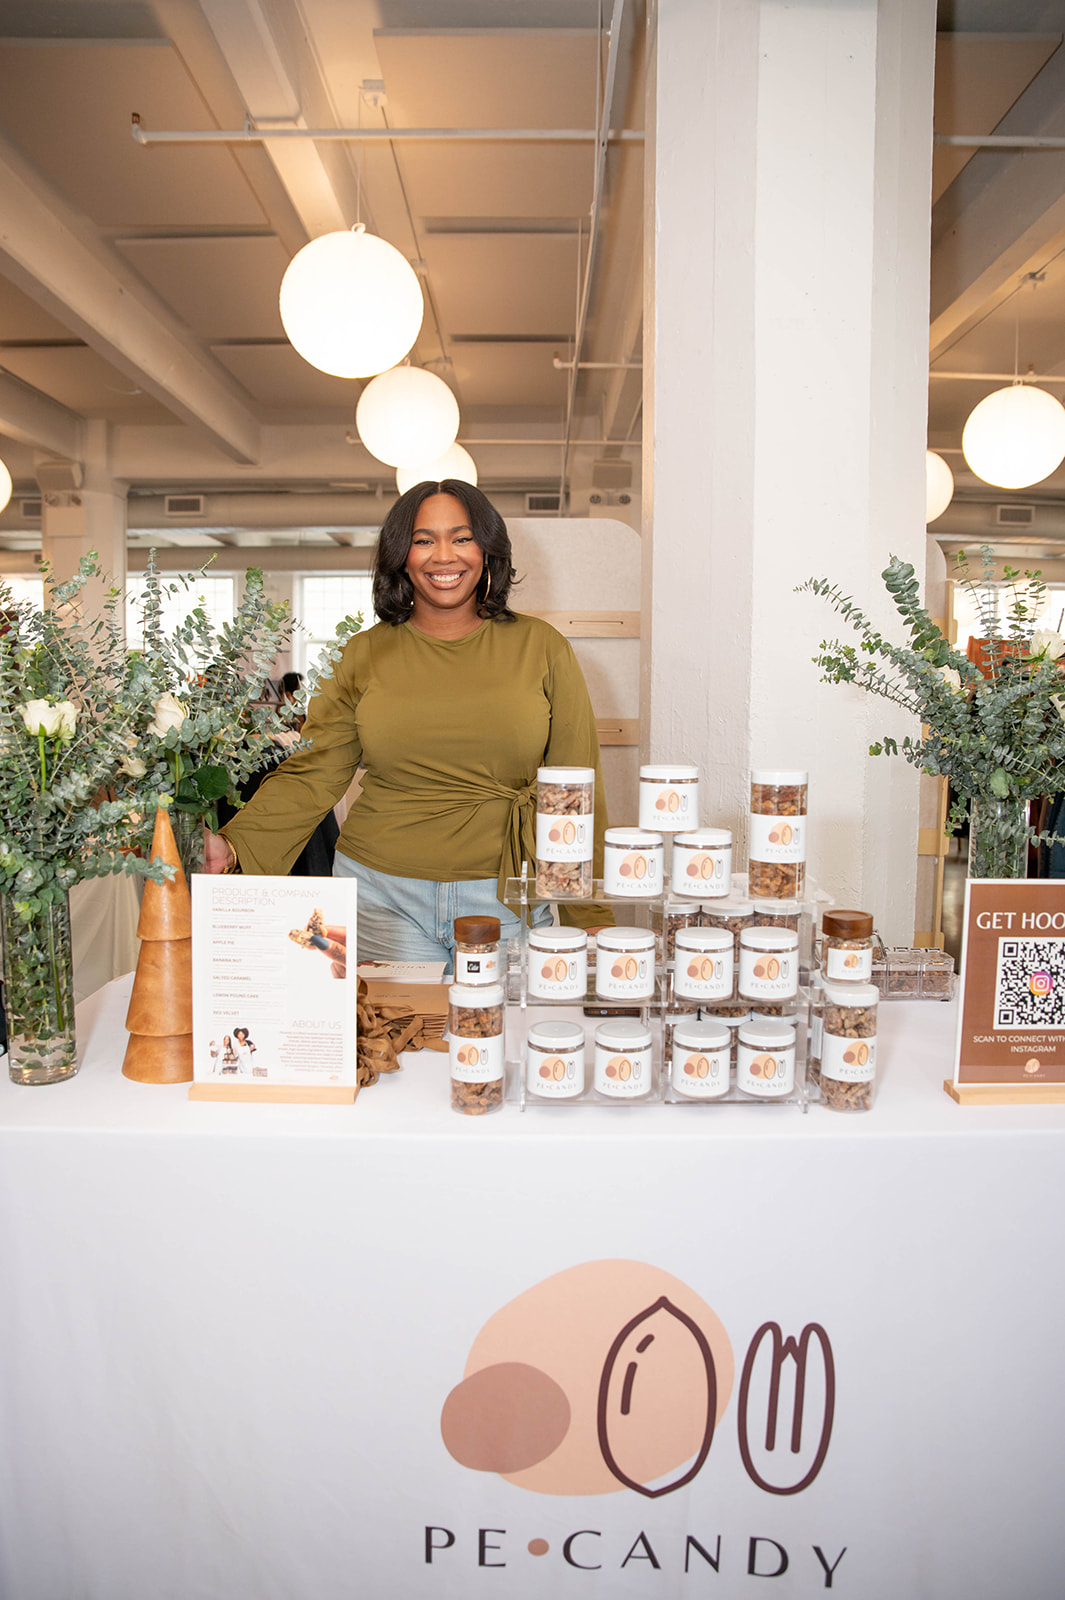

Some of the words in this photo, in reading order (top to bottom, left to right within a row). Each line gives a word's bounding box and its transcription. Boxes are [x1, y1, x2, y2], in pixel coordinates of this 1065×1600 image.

[212, 887, 259, 897] PRODUCT
[262, 889, 268, 897] &
[271, 889, 321, 898] COMPANY
[212, 896, 276, 906] DESCRIPTION
[976, 911, 1017, 930] GET
[1021, 912, 1065, 930] HOO
[292, 1019, 325, 1029] ABOUT
[328, 1020, 342, 1030] US
[973, 1035, 995, 1043] SCAN
[996, 1035, 1007, 1043] TO
[1008, 1035, 1046, 1043] CONNECT
[1010, 1045, 1056, 1053] INSTAGRAM
